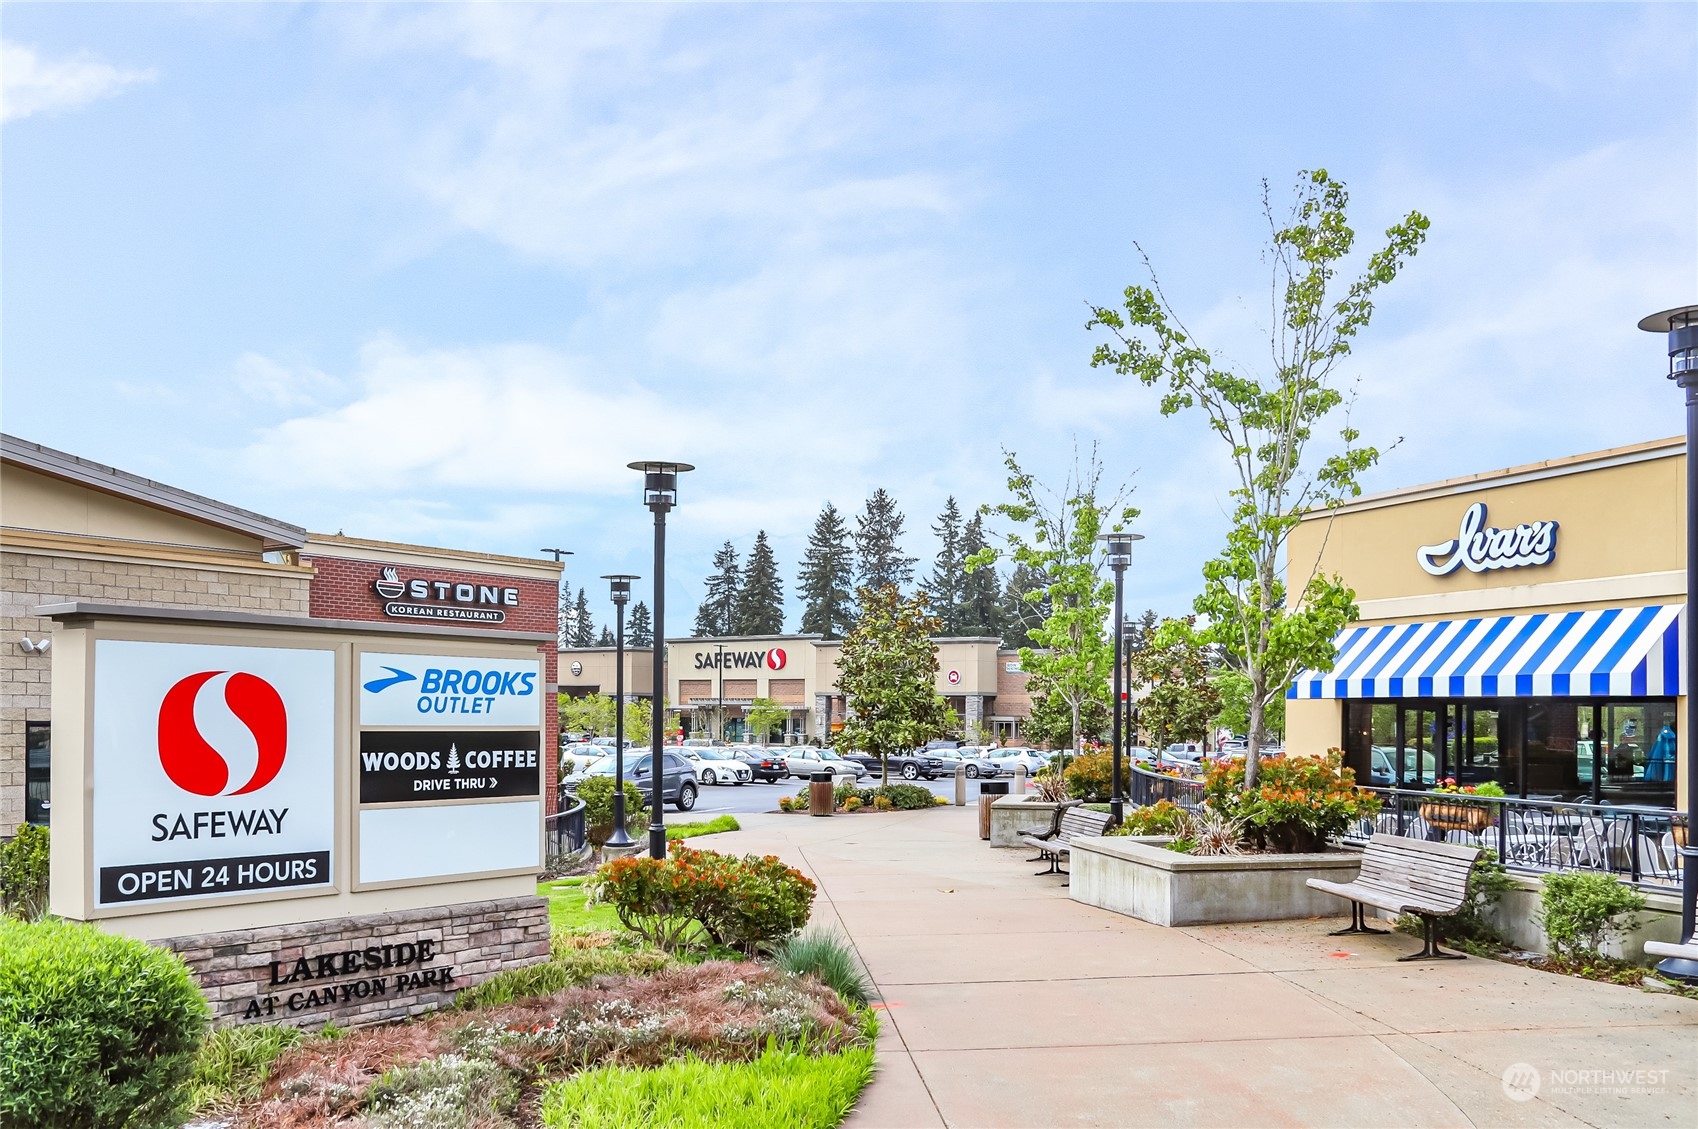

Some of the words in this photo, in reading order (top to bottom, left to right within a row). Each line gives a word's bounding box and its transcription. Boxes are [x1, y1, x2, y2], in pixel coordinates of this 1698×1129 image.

[1416, 502, 1560, 576] Ivar's
[410, 579, 519, 606] STONE
[391, 605, 433, 616] KOREAN
[436, 609, 499, 620] RESTAURANT
[694, 651, 766, 669] SAFEWAY
[420, 668, 537, 695] BROOKS
[417, 696, 495, 714] OUTLET
[361, 751, 441, 772] WOODS
[465, 750, 537, 768] COFFEE
[413, 778, 450, 791] DRIVE
[454, 777, 486, 789] THRU
[151, 808, 289, 842] SAFEWAY
[117, 868, 192, 896] OPEN
[201, 865, 230, 888] 24
[238, 858, 317, 885] HOURS
[268, 938, 435, 987] LAKESIDE
[243, 997, 280, 1019] AT
[287, 977, 387, 1012] CANYON
[396, 966, 455, 993] PARK
